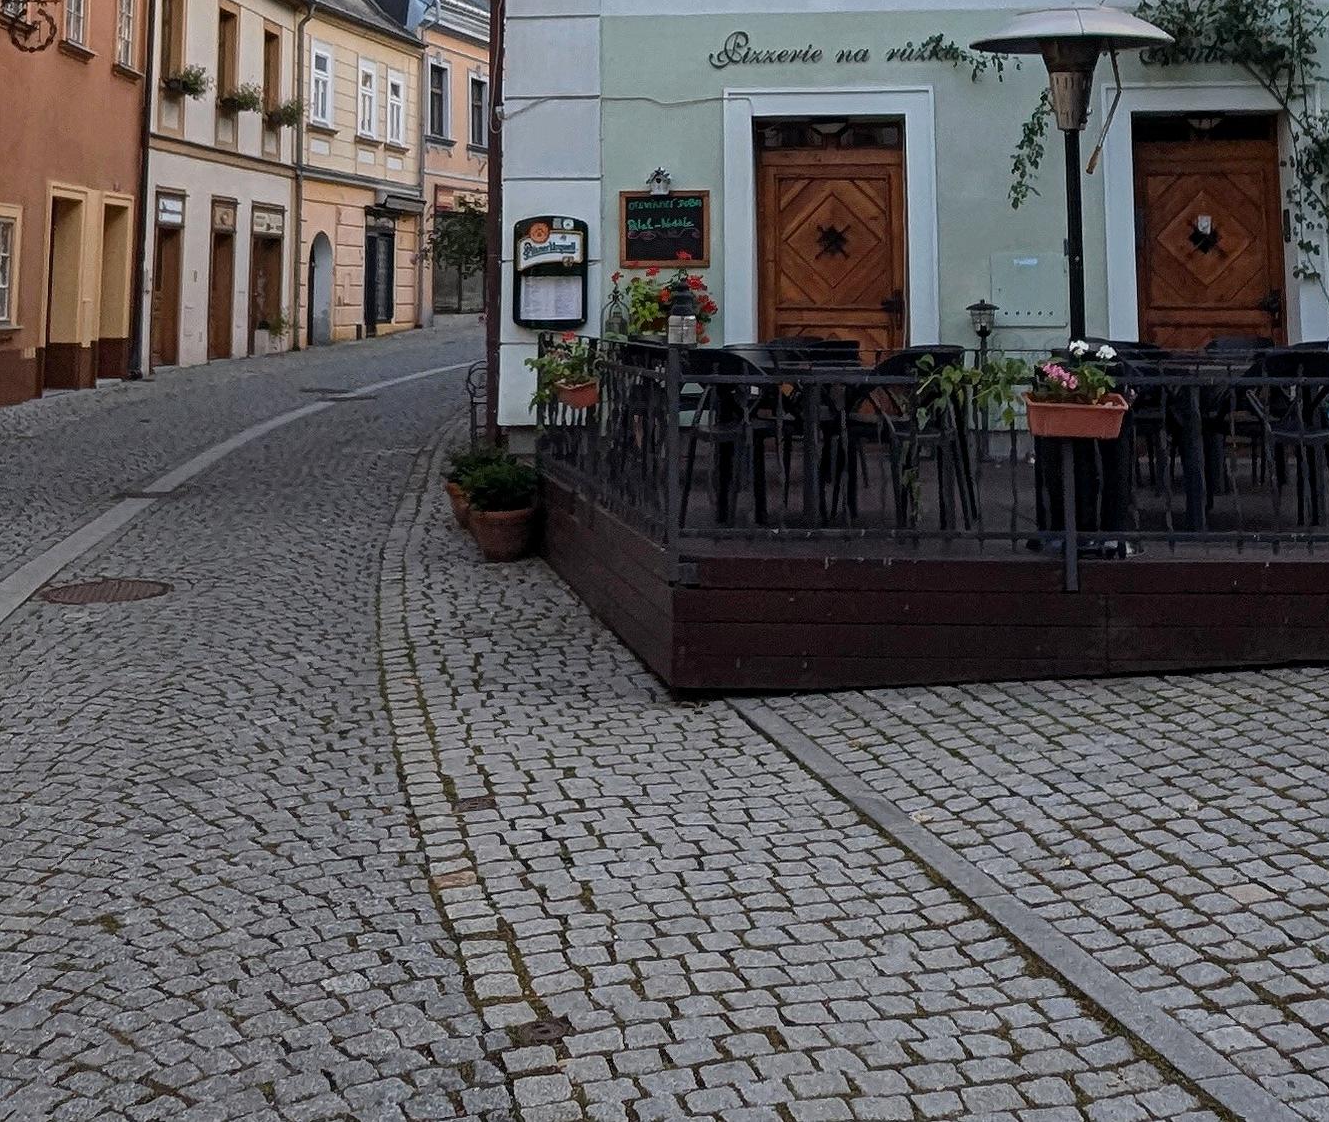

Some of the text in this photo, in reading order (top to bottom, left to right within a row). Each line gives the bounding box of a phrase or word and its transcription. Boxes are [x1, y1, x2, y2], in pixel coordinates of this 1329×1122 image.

[708, 31, 823, 69] Pizzerie
[835, 47, 870, 64] na
[522, 241, 576, 261] Pilsner Urquell
